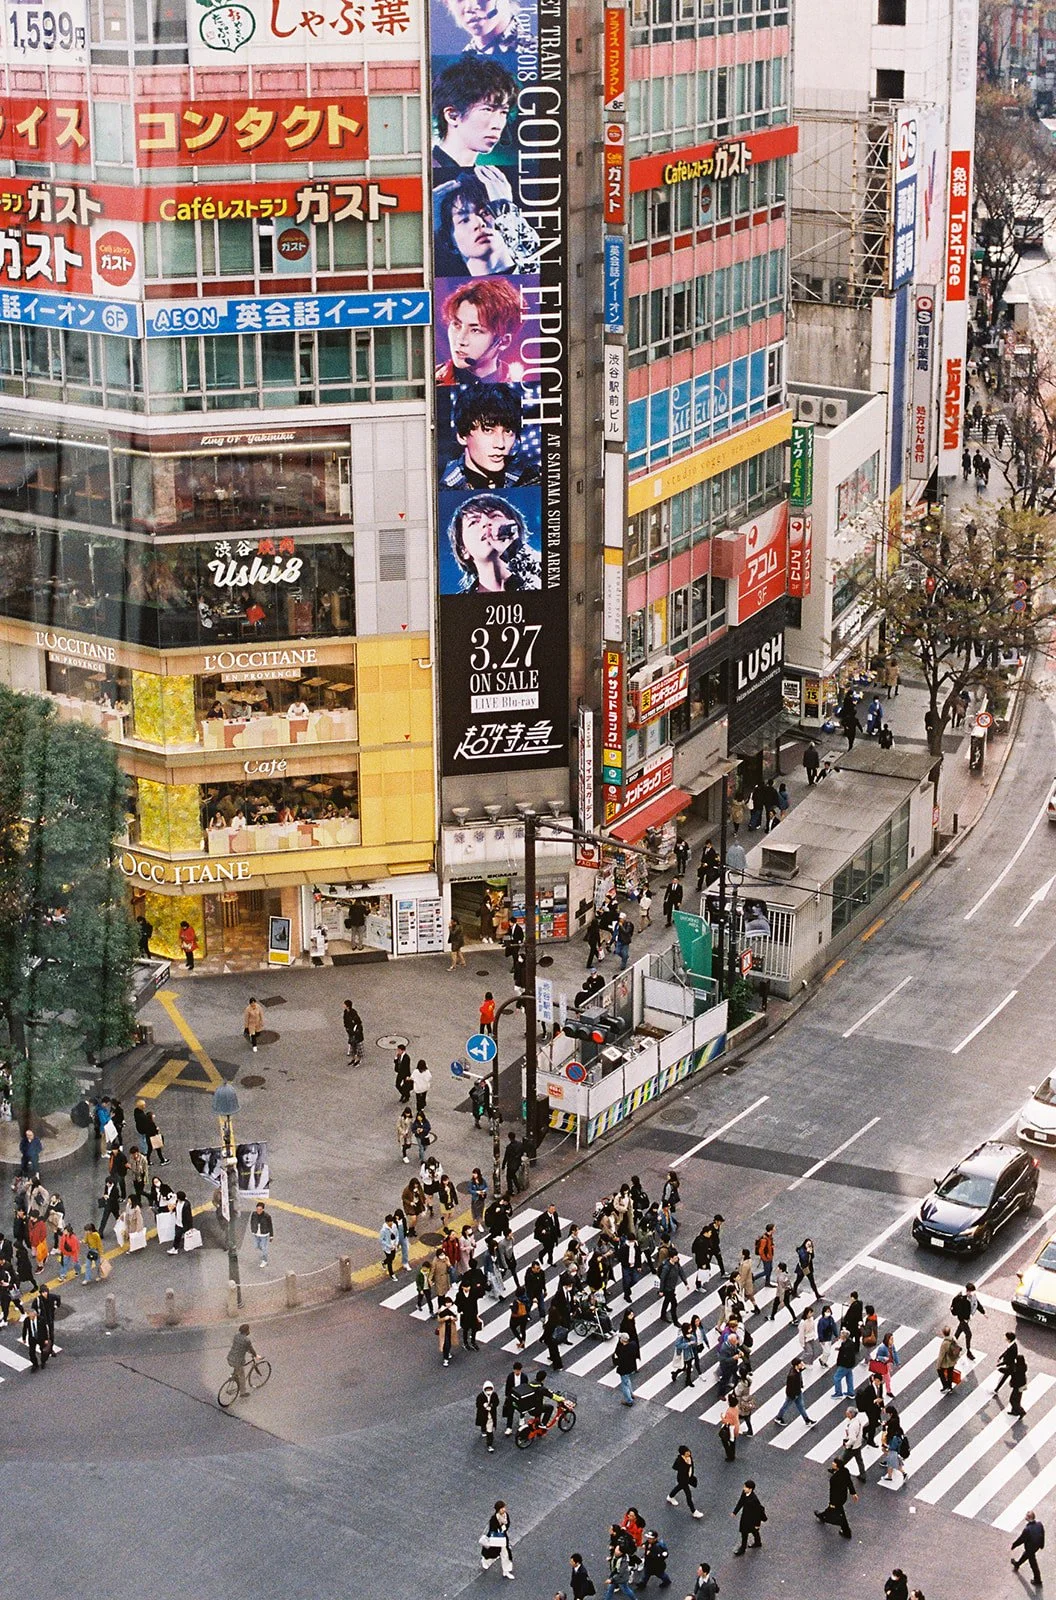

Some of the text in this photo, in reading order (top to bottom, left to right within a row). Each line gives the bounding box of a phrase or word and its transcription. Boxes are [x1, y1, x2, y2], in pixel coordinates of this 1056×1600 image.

[9, 10, 86, 54] 1,599円
[270, 0, 410, 38] しゃぶ葉
[541, 25, 562, 81] TRAIN
[609, 11, 620, 96] プライス コンタクト
[612, 101, 624, 110] 8F
[0, 105, 89, 151] イス
[138, 104, 360, 151] コンタクト
[900, 119, 918, 165] OS
[517, 86, 562, 267] GOLDEN
[714, 141, 753, 180] ガスト
[608, 166, 622, 214] ガスト
[952, 166, 968, 198] 免税
[0, 183, 101, 226] ラン ガスト
[296, 184, 398, 225] ガスト
[0, 228, 83, 283] ガスト
[101, 254, 132, 271] ガスト
[281, 241, 307, 252] ガスト
[609, 245, 620, 323] 英会話イーオン
[0, 294, 125, 328] 話イーオン 6F
[154, 298, 425, 331] AEON 英会話イーオン
[519, 282, 563, 428] EPOCH
[608, 353, 620, 433] 渋谷駅前ビル
[547, 433, 561, 448] AT
[914, 405, 926, 463] 処方せん受付
[547, 453, 561, 506] SAITAMA
[547, 510, 561, 548] SUPER
[207, 555, 304, 588] Ushi8
[547, 551, 561, 589] ARENA
[747, 547, 778, 587] アコム
[791, 549, 802, 581] アコム
[485, 603, 526, 625] 2019.
[756, 586, 768, 606] 3F
[35, 631, 117, 662] L'OCCITANE
[204, 648, 318, 671] L'OCCITANE
[470, 624, 542, 671] 3.27
[737, 632, 783, 690] LUSH
[244, 669, 299, 681] PROVENCE
[470, 669, 540, 693] ON SALE
[651, 679, 679, 706] サンドラッグ
[474, 695, 536, 710] LIVE Blu-ray
[608, 679, 618, 742] サンドラッグ
[244, 758, 288, 776] Café
